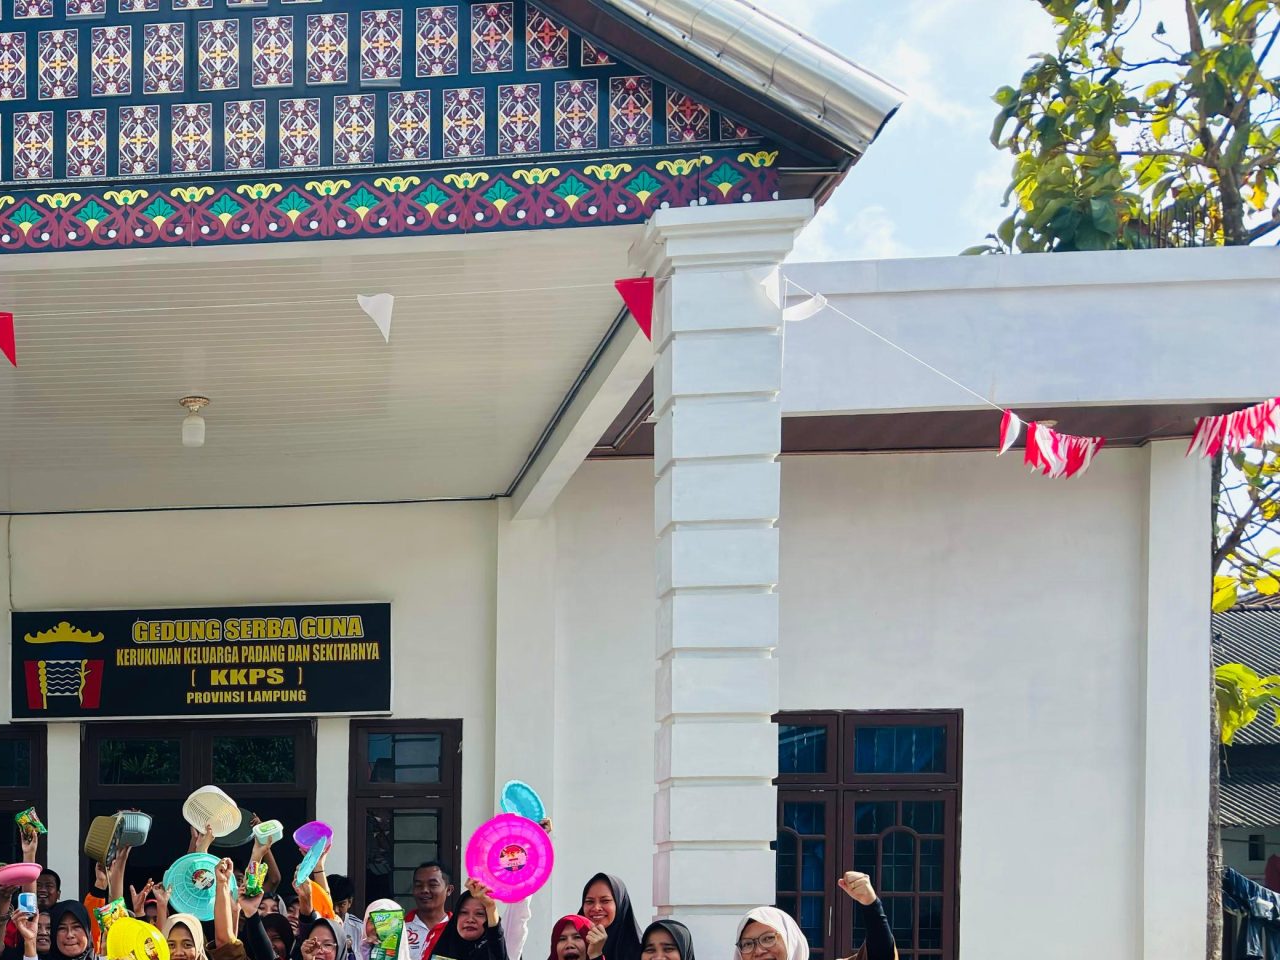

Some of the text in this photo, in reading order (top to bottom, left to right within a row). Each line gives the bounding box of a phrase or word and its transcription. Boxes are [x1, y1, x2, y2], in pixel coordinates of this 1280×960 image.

[132, 616, 364, 643] GEDUNG SERBA GUNA
[116, 642, 380, 666] KERUKUNAN KELUARGA PADANG DAN SEKITARNYA
[210, 667, 284, 686] KKPS
[186, 689, 307, 704] PROVINSI LAMPUNG
